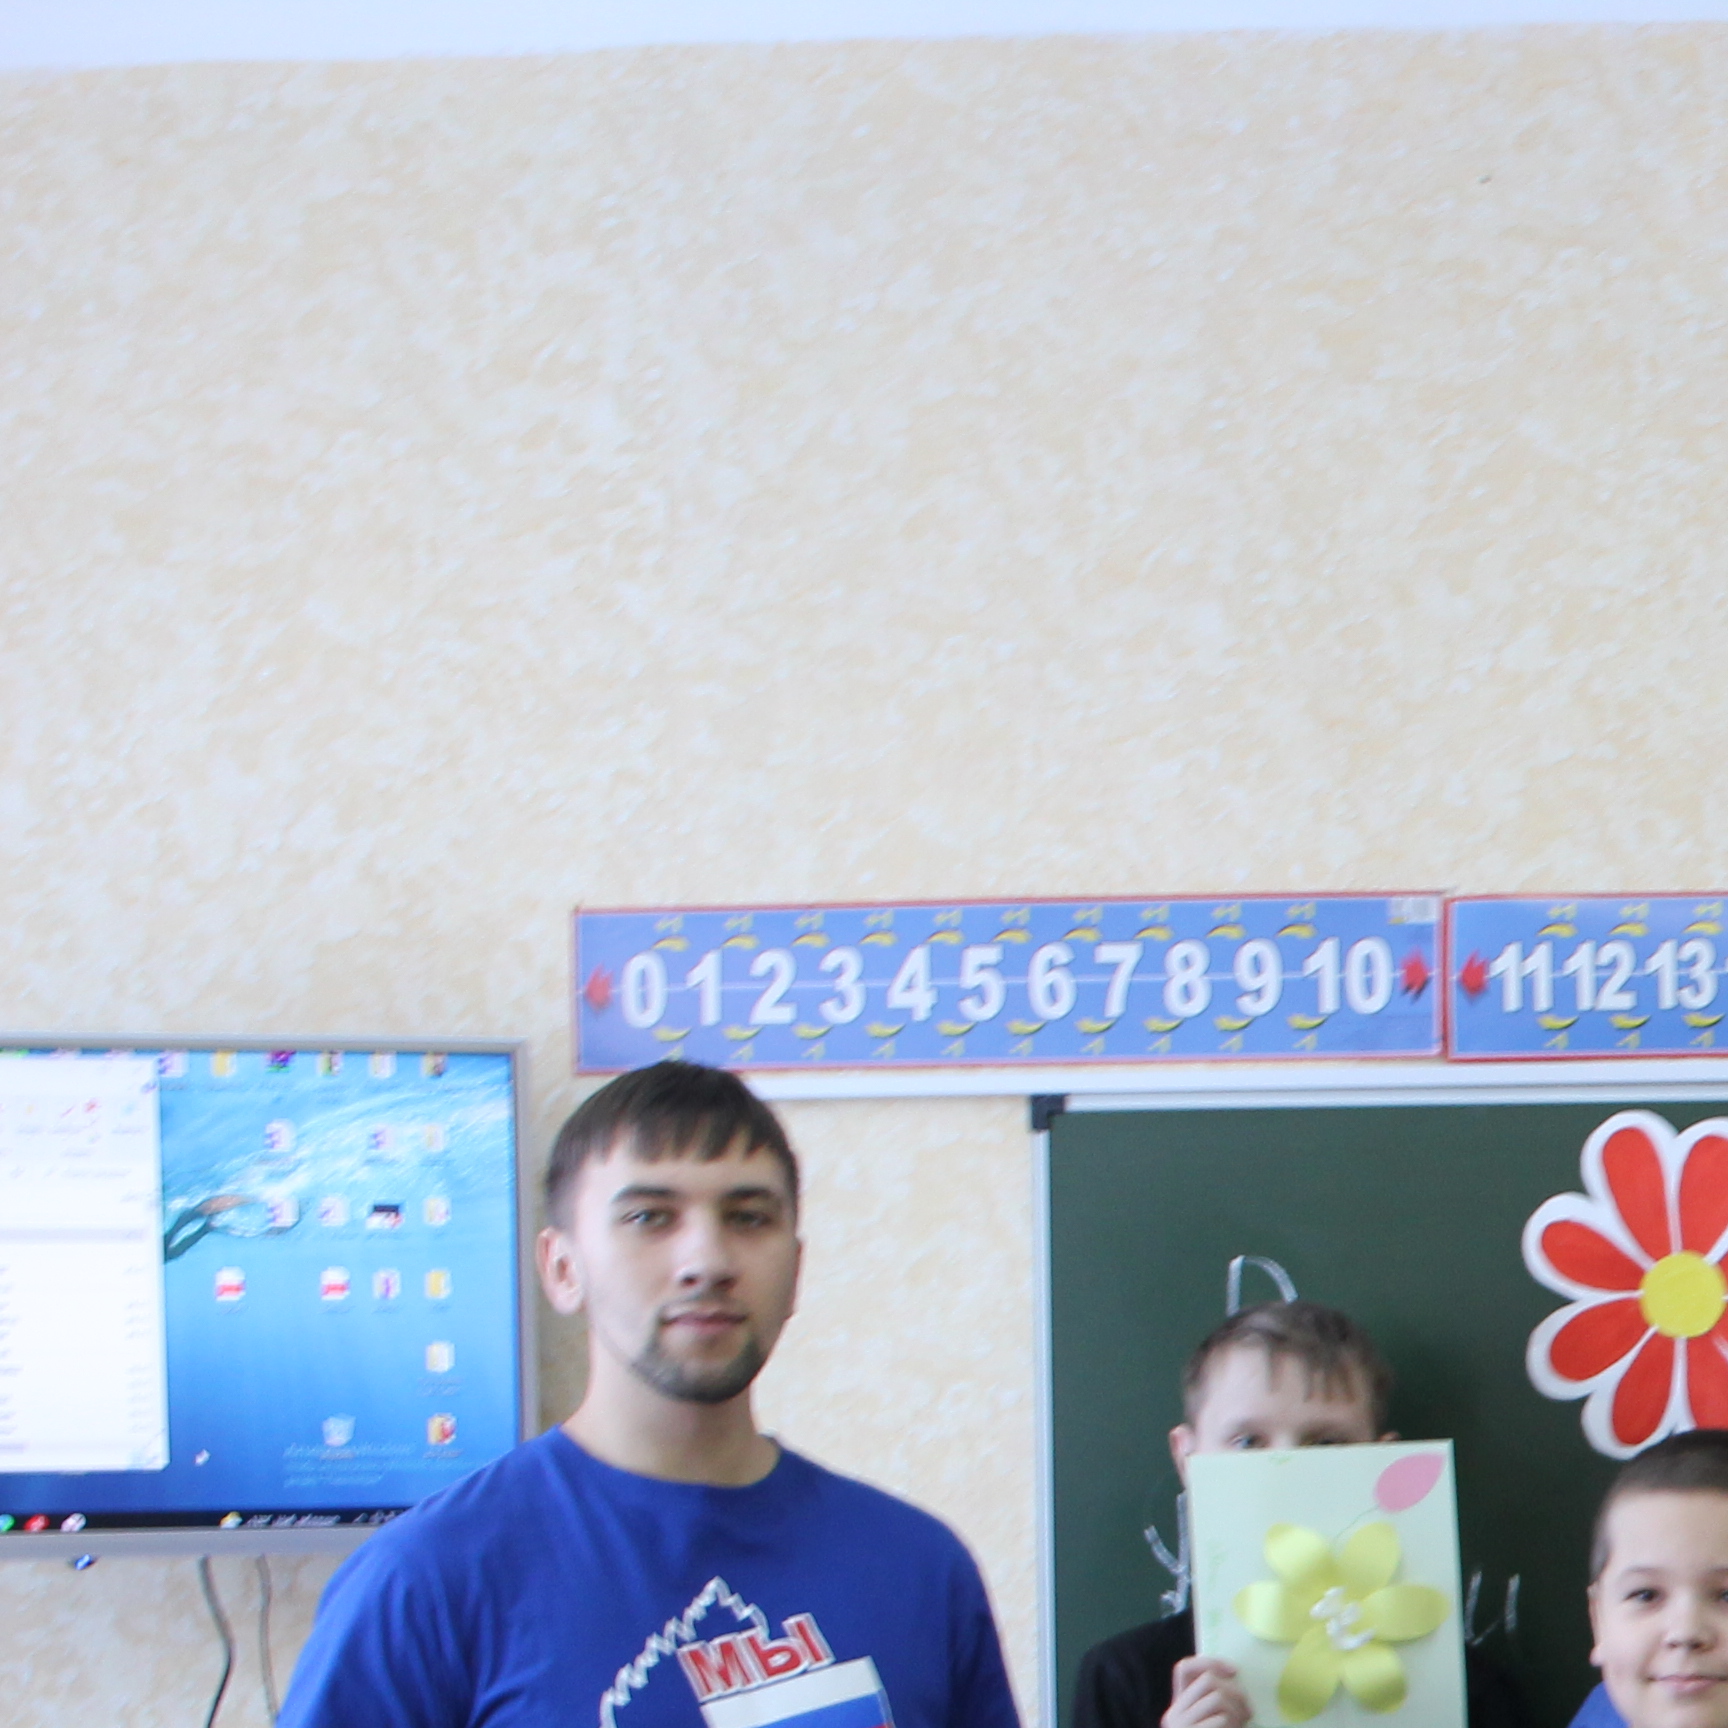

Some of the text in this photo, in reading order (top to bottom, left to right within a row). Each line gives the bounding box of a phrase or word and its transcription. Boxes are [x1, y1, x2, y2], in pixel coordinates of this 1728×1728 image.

[621, 937, 1392, 1026] 0 1 2 3 4 5 6 7 8 9 10
[1485, 943, 1553, 1011] 11
[1563, 940, 1637, 1010] 12
[1645, 938, 1718, 1009] 13
[677, 1612, 834, 1701] МЫ
